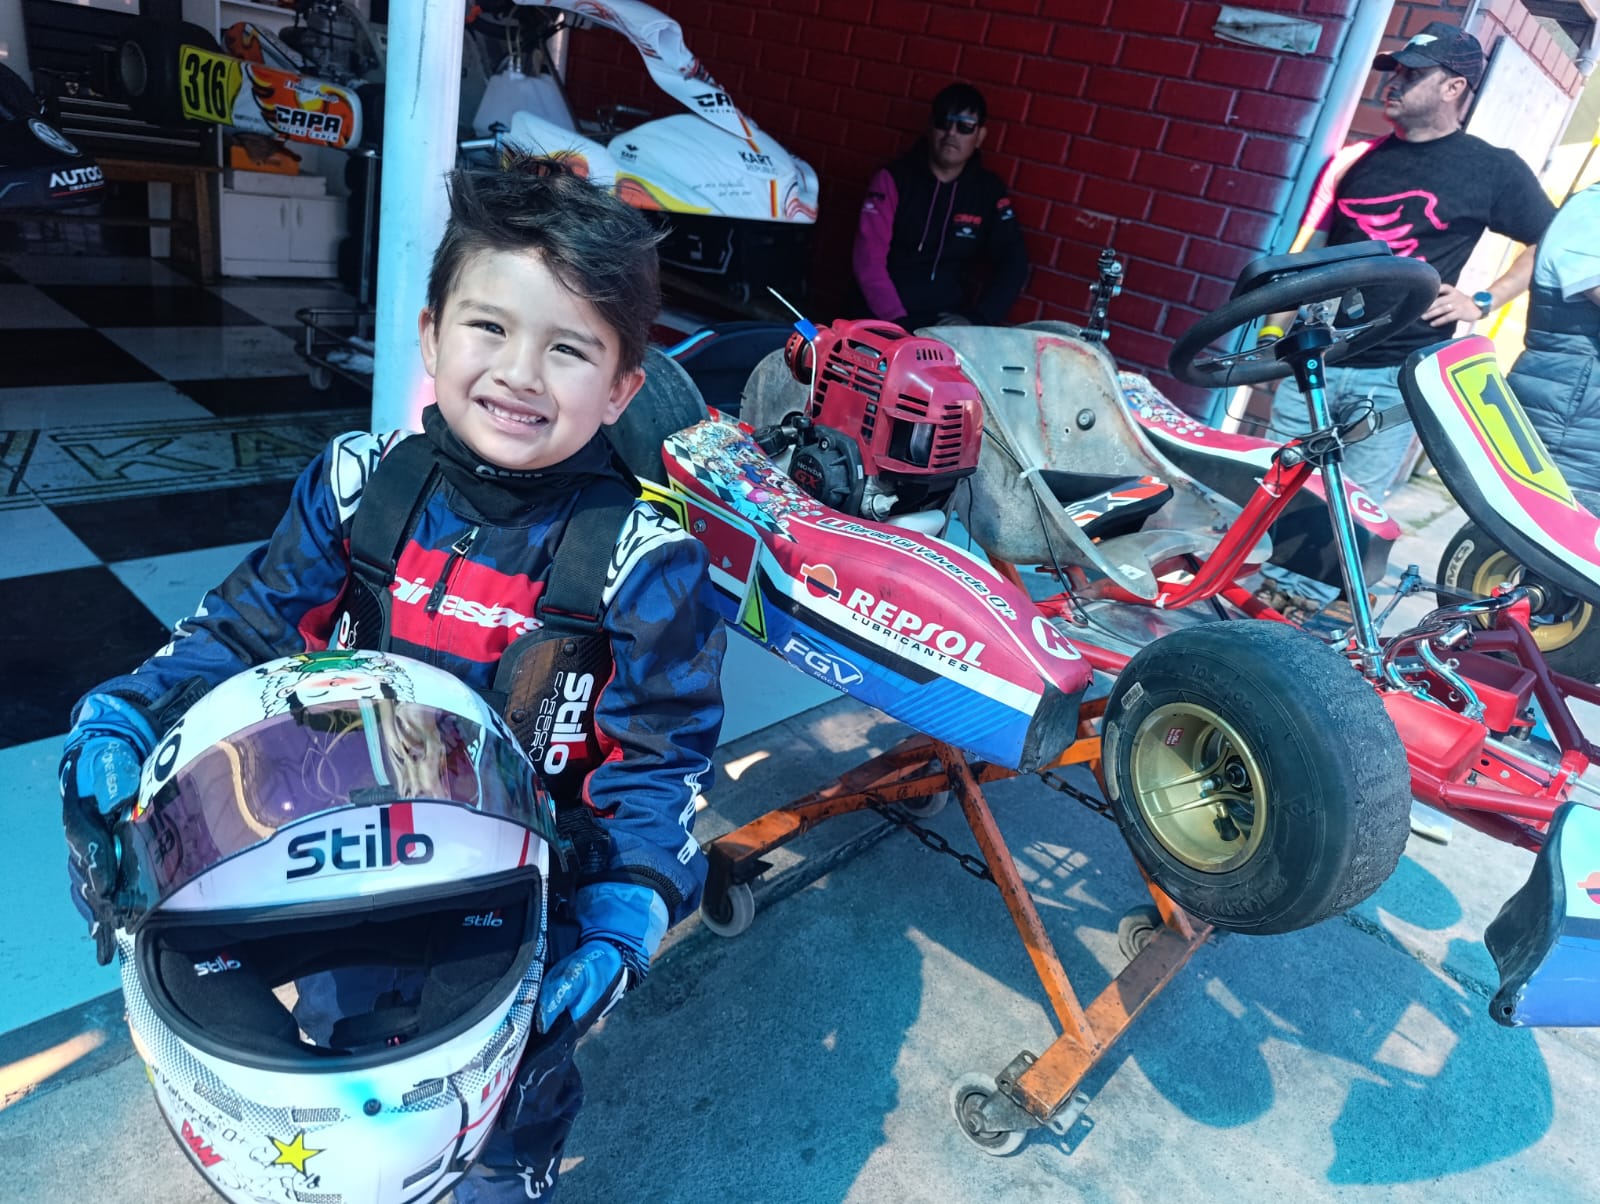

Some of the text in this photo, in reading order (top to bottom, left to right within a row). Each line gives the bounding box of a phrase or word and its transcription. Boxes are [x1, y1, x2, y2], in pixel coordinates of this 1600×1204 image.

[184, 53, 227, 119] 316
[276, 106, 341, 133] CAPA
[738, 151, 773, 167] KART
[1480, 373, 1545, 475] 1
[795, 471, 820, 490] GX
[797, 461, 823, 479] HONDA
[916, 546, 989, 593] Valverde
[847, 588, 986, 667] REPSOL
[851, 613, 969, 672] LUBRICANTES
[784, 638, 861, 685] FGV
[543, 672, 595, 775] Stilo
[286, 806, 435, 880] Stilo
